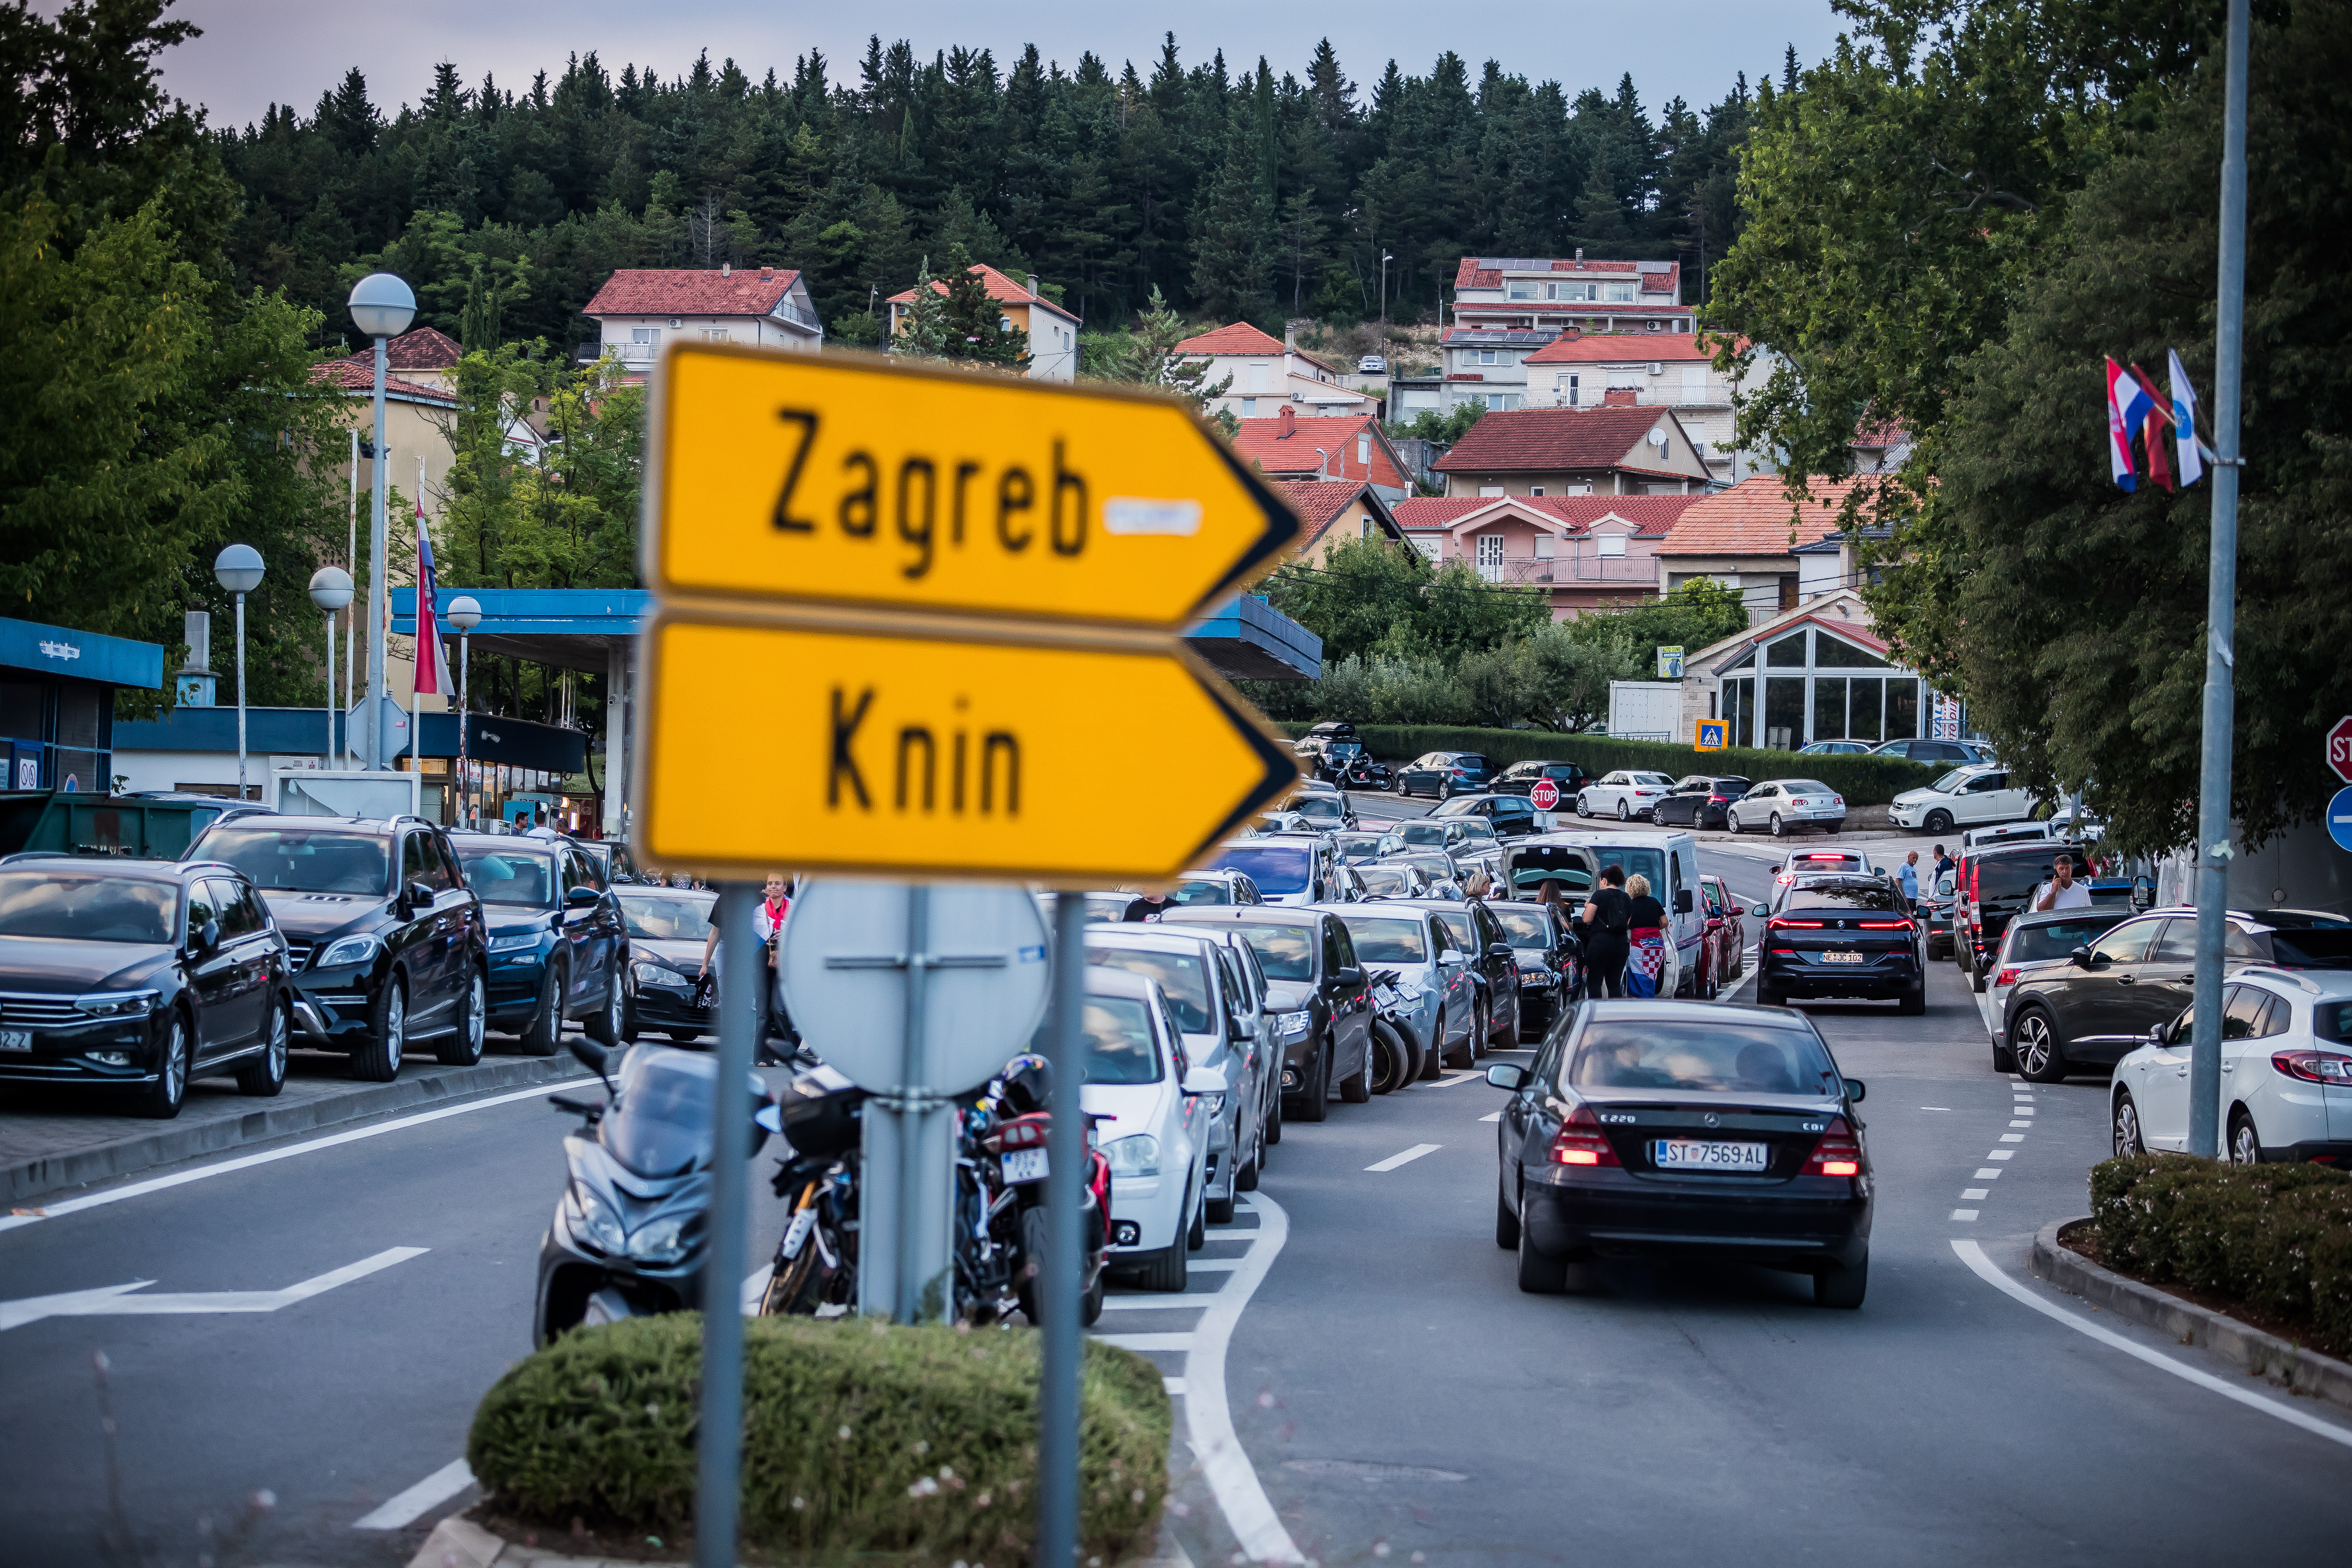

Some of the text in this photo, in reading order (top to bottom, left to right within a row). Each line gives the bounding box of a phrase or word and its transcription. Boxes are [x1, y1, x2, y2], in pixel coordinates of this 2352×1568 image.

[771, 406, 1091, 579] Zagreb
[825, 686, 1022, 815] Knin
[1532, 790, 1557, 802] STOP
[1610, 1115, 1636, 1123] 220
[1669, 1144, 1688, 1162] ST
